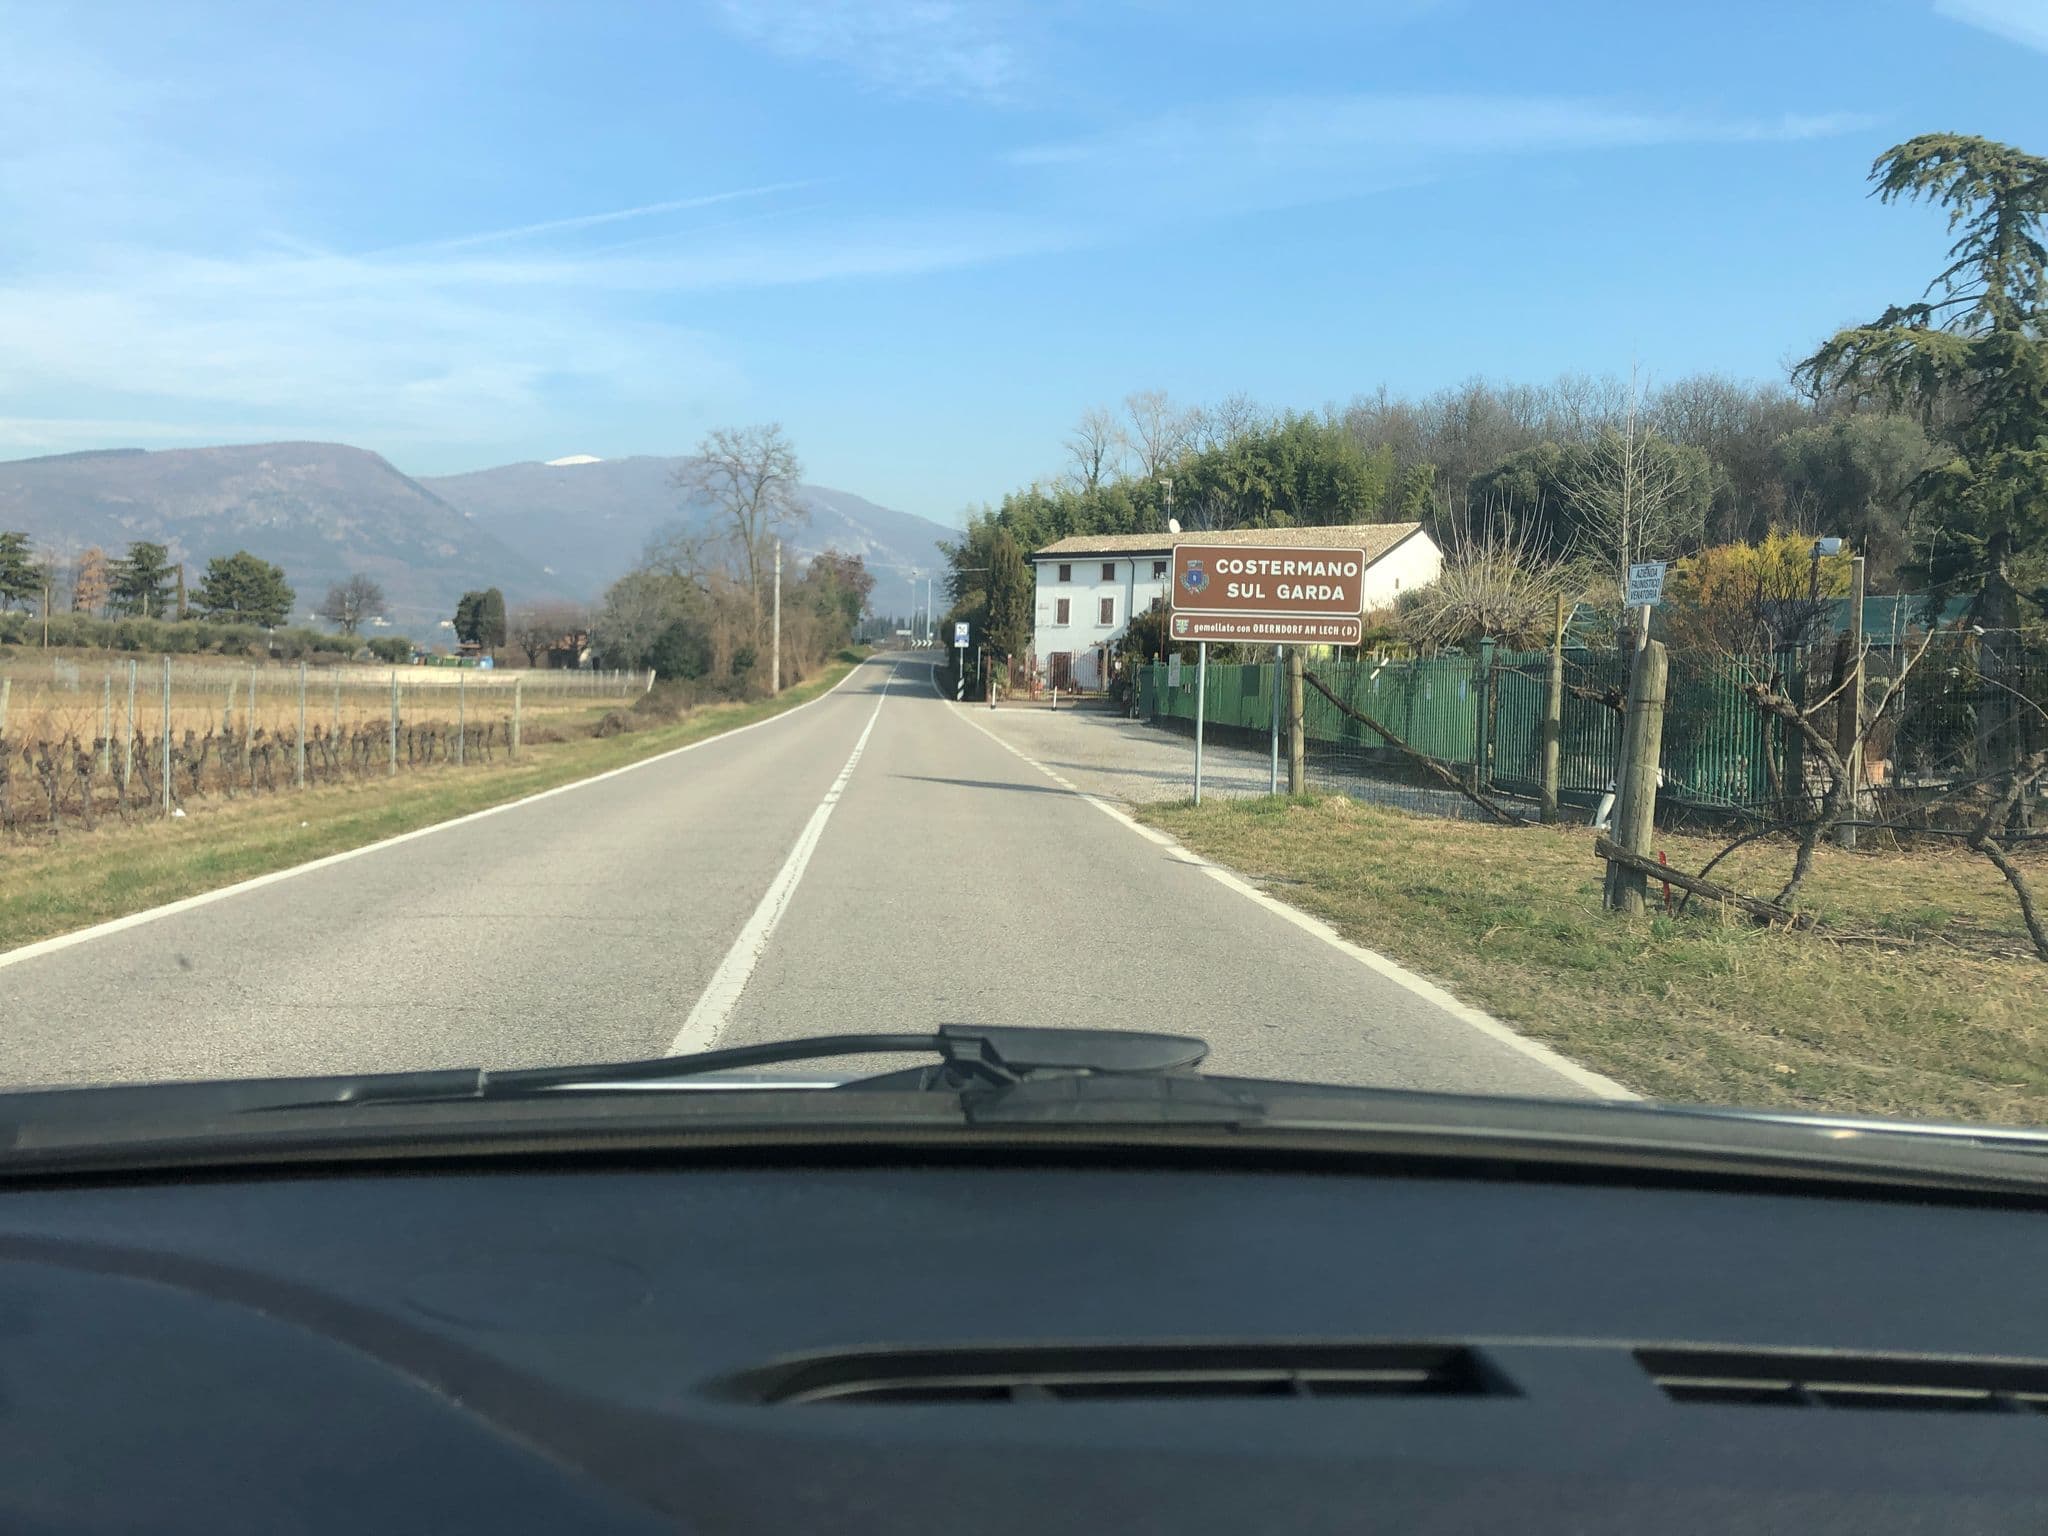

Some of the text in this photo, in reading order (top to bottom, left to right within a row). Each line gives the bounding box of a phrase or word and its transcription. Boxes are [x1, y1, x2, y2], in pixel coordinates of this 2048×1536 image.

[1215, 559, 1358, 577] COSTERMANO
[1636, 568, 1658, 578] AZIENDA
[1227, 582, 1345, 600] SUL GARDA
[1236, 625, 1251, 633] con
[1252, 623, 1303, 634] OBERNDORF
[1319, 625, 1339, 636] LECH
[1341, 626, 1357, 637] (D)
